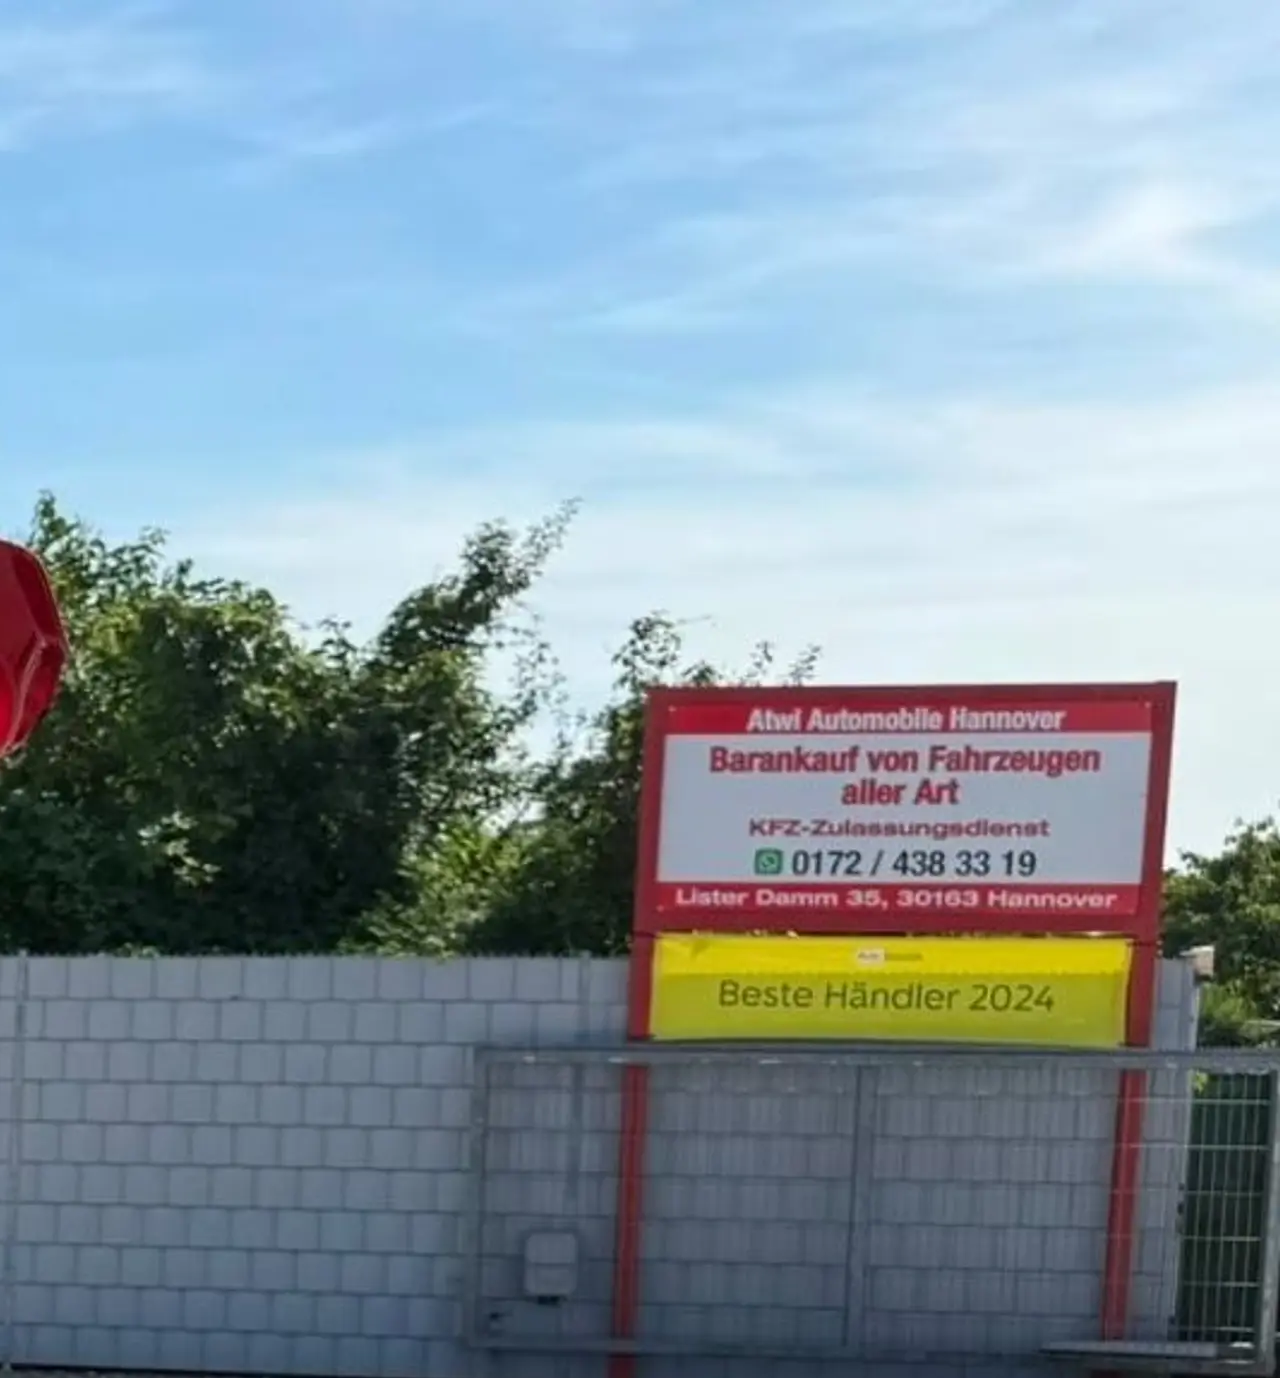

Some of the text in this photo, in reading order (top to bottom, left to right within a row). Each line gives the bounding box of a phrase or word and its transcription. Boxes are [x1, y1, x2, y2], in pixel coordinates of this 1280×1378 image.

[746, 706, 1067, 731] Atwi Automobile Hannover
[709, 744, 1102, 778] Barankauf von Fahrzeugen
[841, 777, 960, 806] aller Art
[748, 818, 1051, 841] KFZ-Zulassungsdienst
[791, 849, 1038, 877] 0172 / 438 33 19
[675, 886, 1119, 911] Lister Damm 35, 30163 Hannover
[718, 978, 1055, 1013] Beste Händler 2024
